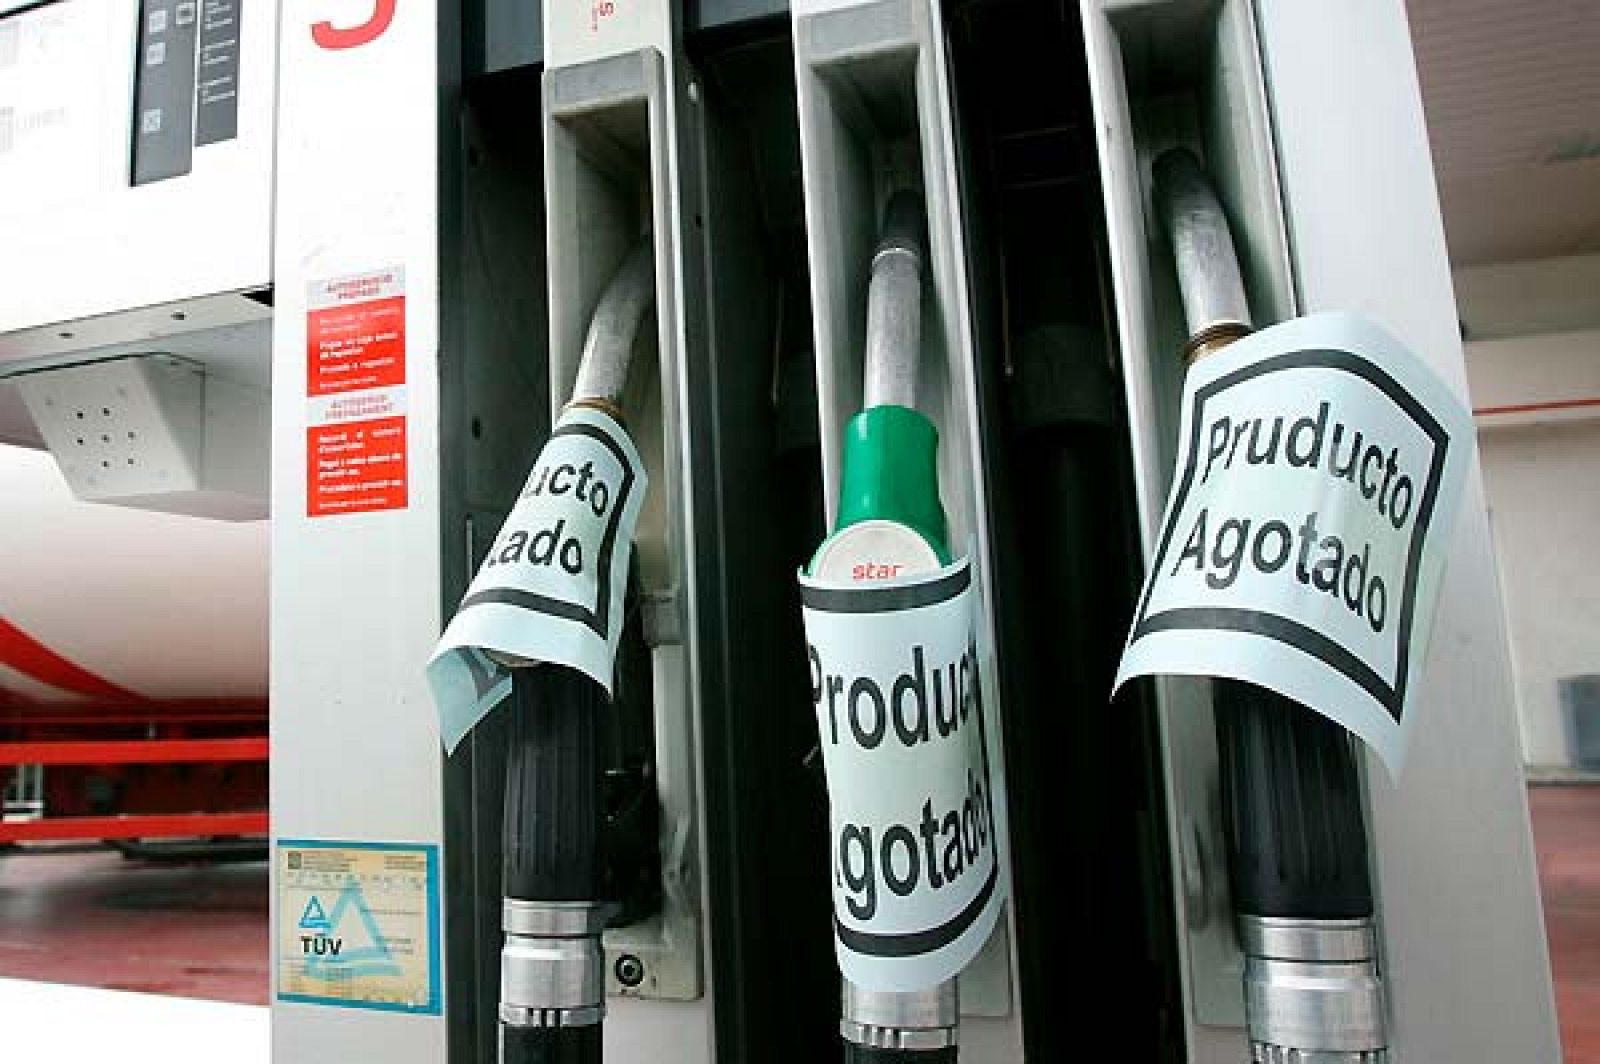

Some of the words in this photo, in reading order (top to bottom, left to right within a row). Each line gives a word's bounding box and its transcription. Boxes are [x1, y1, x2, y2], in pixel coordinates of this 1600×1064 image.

[1201, 402, 1413, 530] Pruducto
[488, 519, 583, 576] ado
[852, 561, 904, 580] star
[1171, 508, 1387, 633] Agotado
[832, 771, 988, 921] gotado
[301, 932, 342, 956] TÜV
